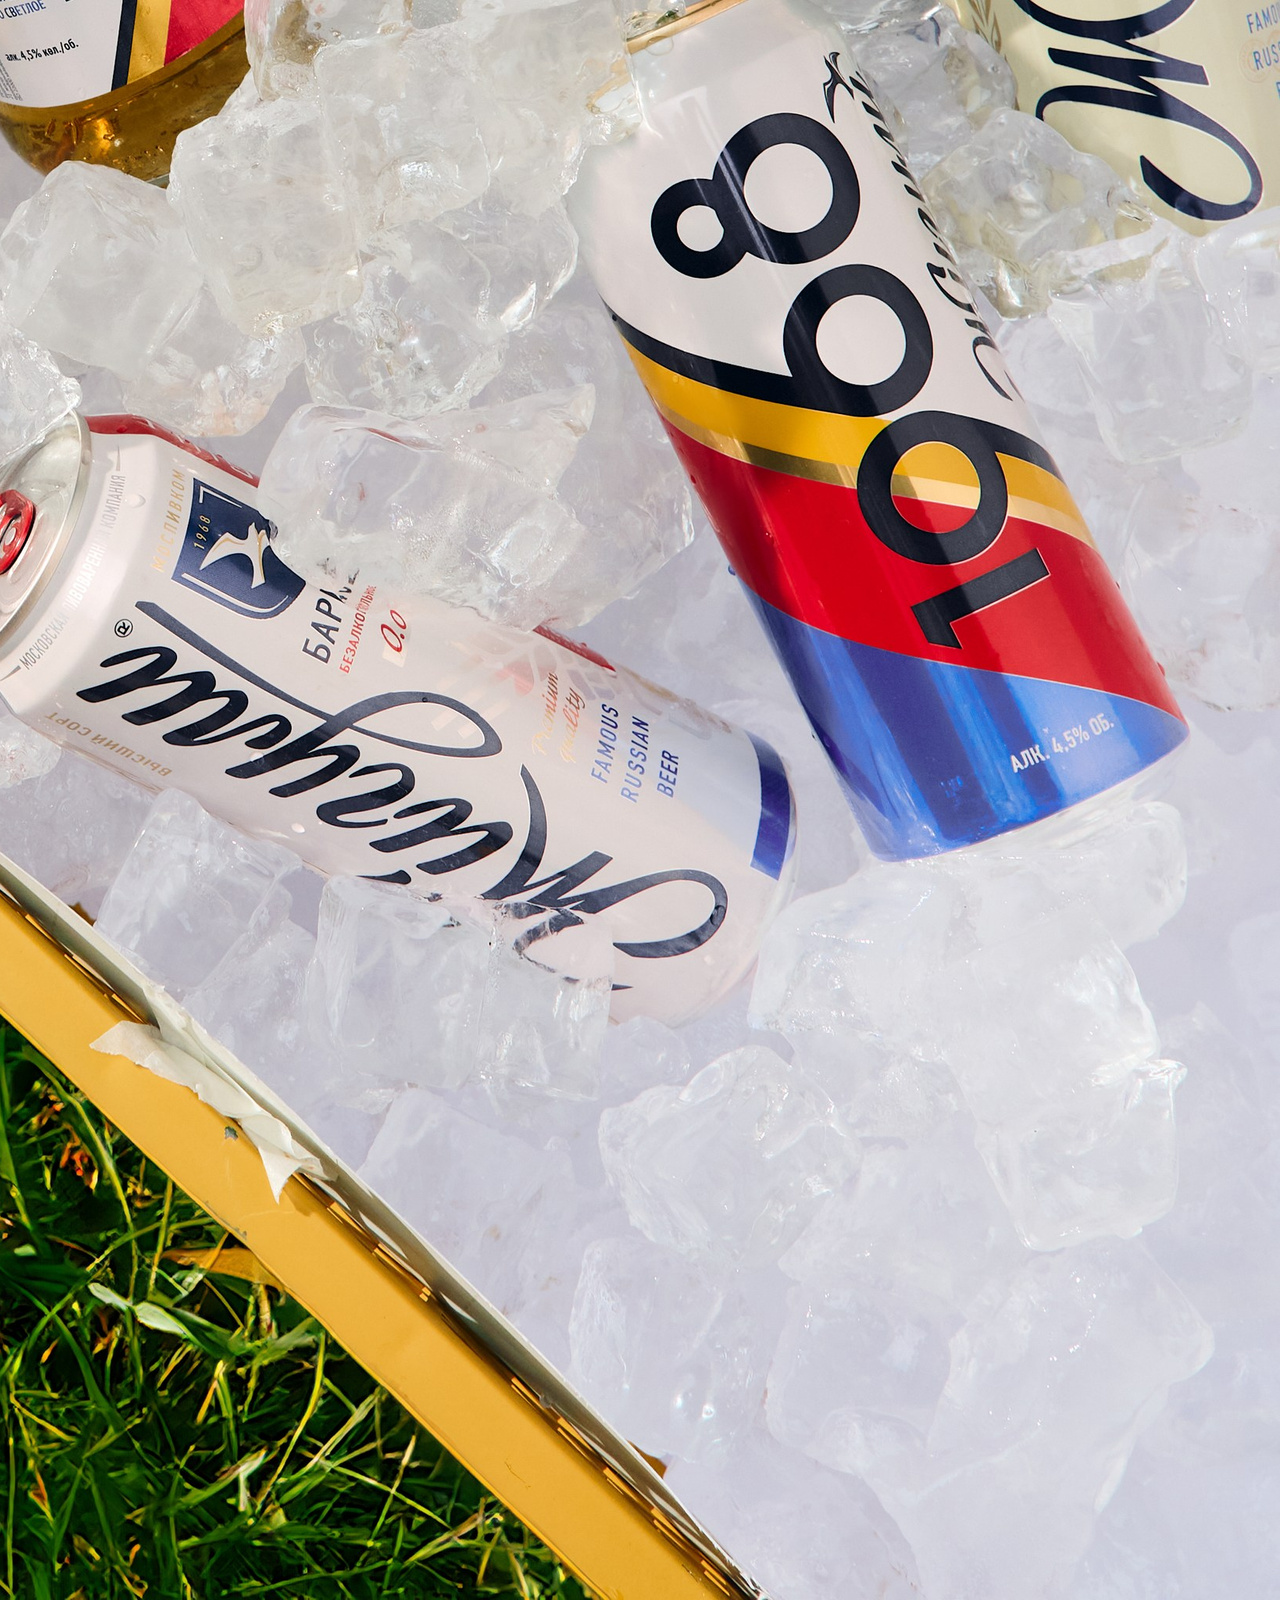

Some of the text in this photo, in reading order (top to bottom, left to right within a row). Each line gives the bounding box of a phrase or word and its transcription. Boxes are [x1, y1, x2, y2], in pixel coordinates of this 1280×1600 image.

[4, 0, 47, 19] СВЕТЛОЕ
[20, 48, 43, 62] 4,5%
[603, 112, 1064, 650] 1968
[101, 474, 126, 531] КОМПАНИЯ
[151, 468, 187, 573] МОСПИВКОМ
[193, 514, 211, 550] 1968
[380, 609, 407, 653] 0.0
[45, 711, 173, 777] ВЫСШИЙ СОРТ
[560, 687, 586, 764] quality
[591, 703, 619, 784] FAMOUS
[1010, 744, 1050, 774] АЛК.
[1088, 713, 1115, 735] ОБ.
[621, 715, 649, 803] RUSSIAN
[656, 749, 679, 798] BEER
[76, 599, 728, 992] Жигули
